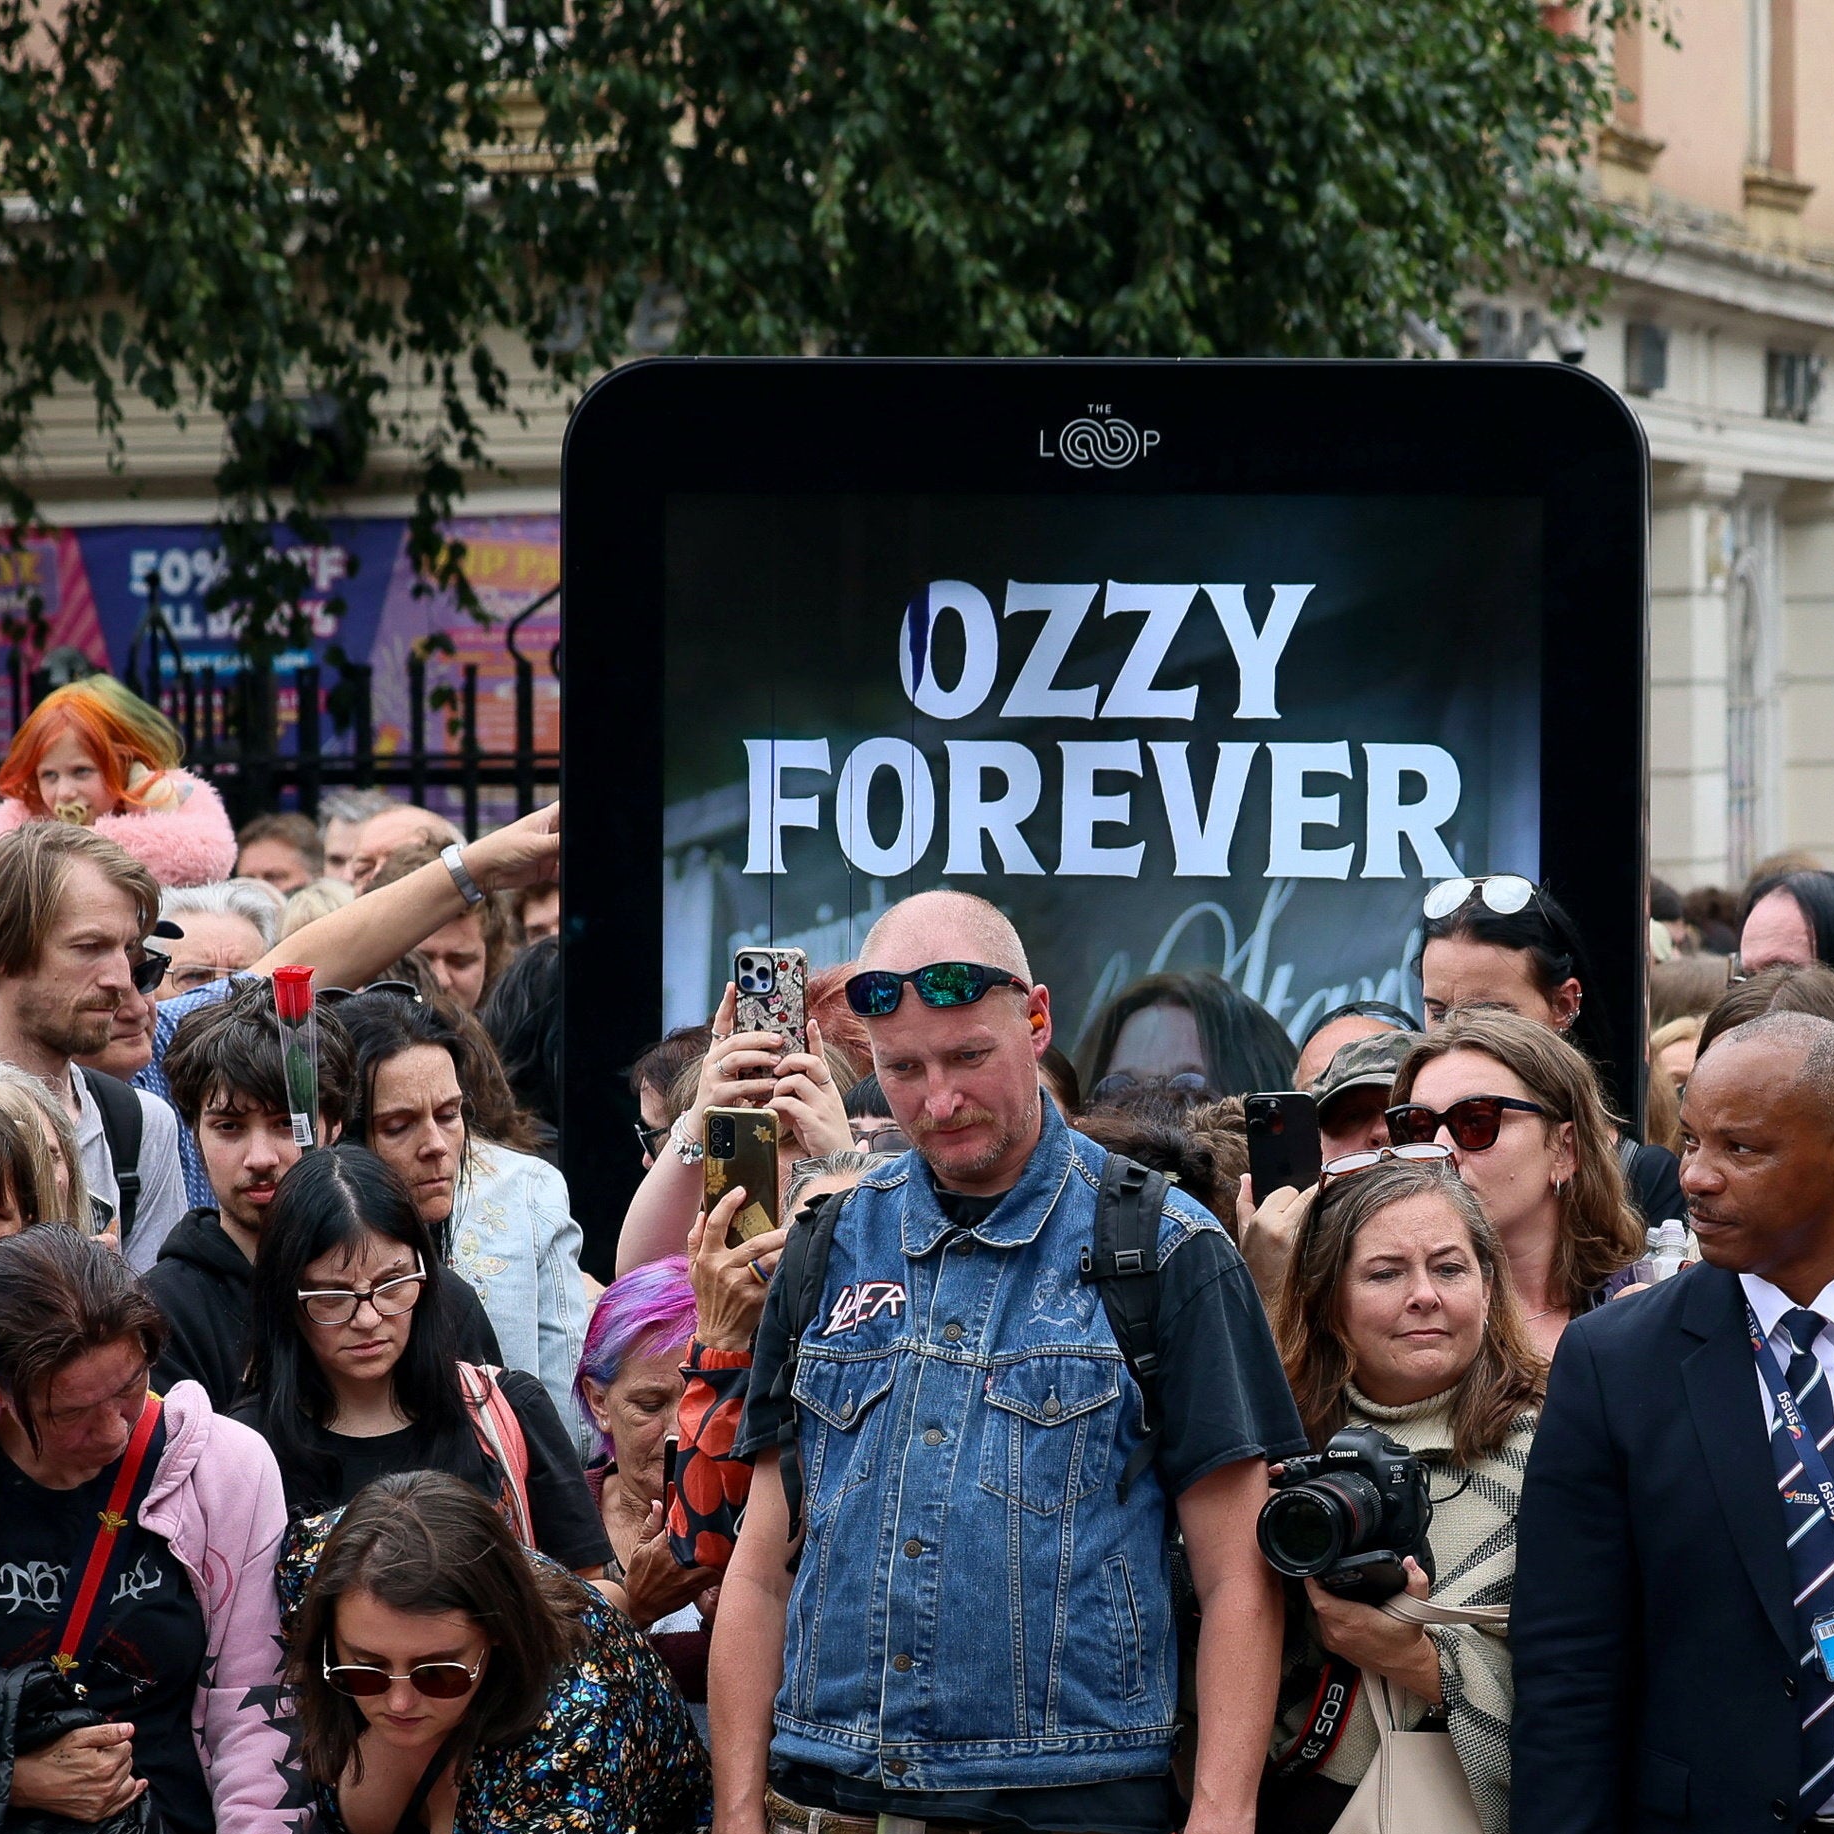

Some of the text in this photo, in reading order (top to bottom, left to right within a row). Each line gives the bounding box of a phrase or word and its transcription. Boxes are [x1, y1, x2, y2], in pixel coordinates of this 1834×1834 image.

[1087, 403, 1112, 415] THE
[1039, 417, 1161, 469] LOOP
[899, 578, 1316, 720] OZZY
[742, 737, 1466, 879] FOREVER
[822, 1279, 907, 1337] SLAYER
[1777, 1390, 1800, 1429] snsg
[1328, 1450, 1359, 1459] Canon
[1389, 1464, 1404, 1472] EOS
[1315, 1682, 1345, 1737] EOS
